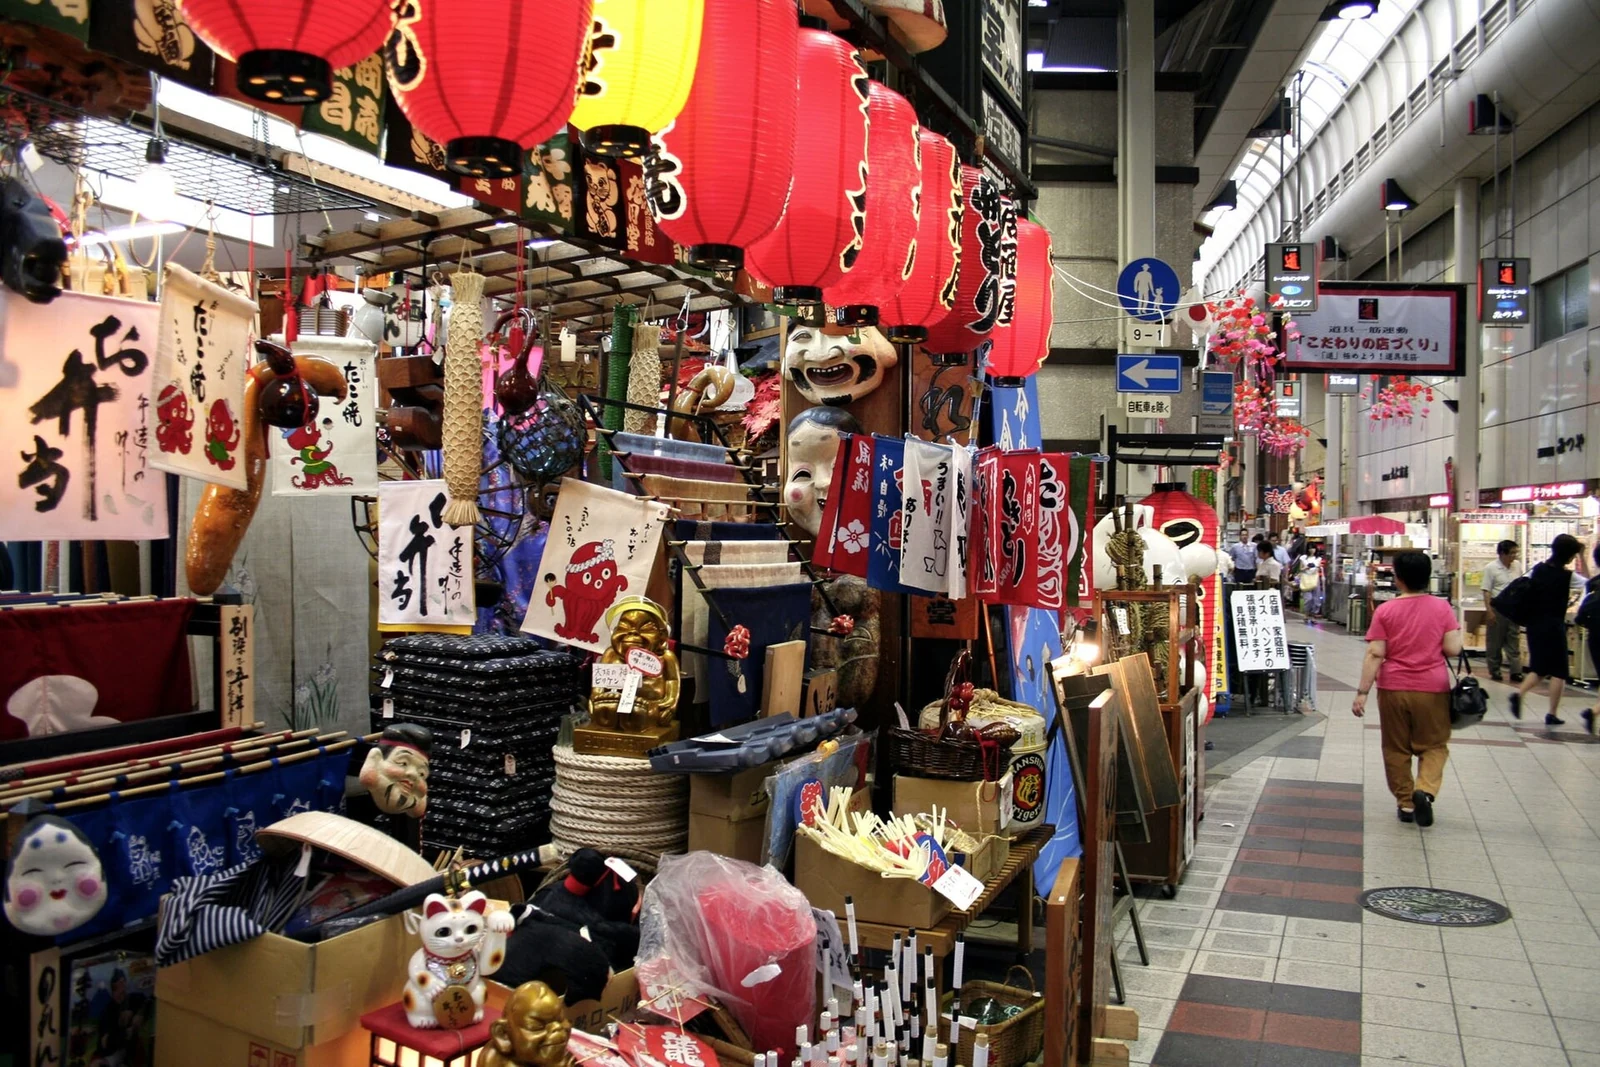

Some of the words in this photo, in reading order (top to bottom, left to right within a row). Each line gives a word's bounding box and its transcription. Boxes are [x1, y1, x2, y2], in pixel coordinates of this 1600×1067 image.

[1128, 401, 1170, 414] 自転車を除く
